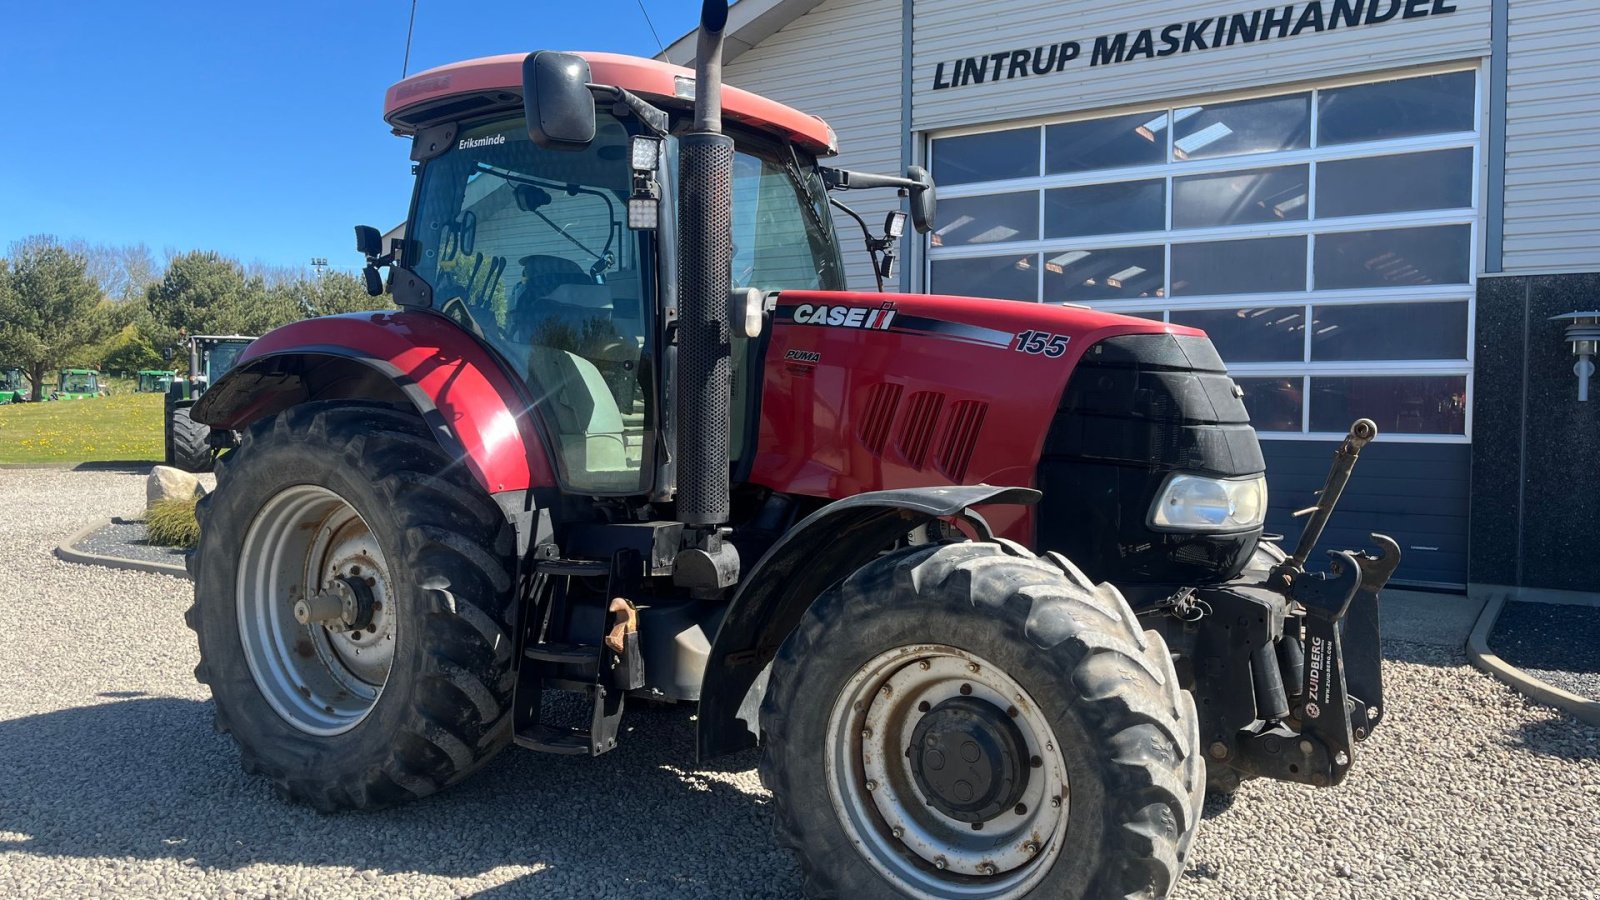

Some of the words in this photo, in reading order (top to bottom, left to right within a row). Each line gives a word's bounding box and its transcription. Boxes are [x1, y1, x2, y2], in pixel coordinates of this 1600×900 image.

[933, 41, 1081, 90] LINTRUP
[459, 133, 506, 150] Eriksminde
[784, 349, 821, 363] PUMA
[1015, 329, 1071, 358] 155
[1309, 636, 1321, 701] ZUIDBERG
